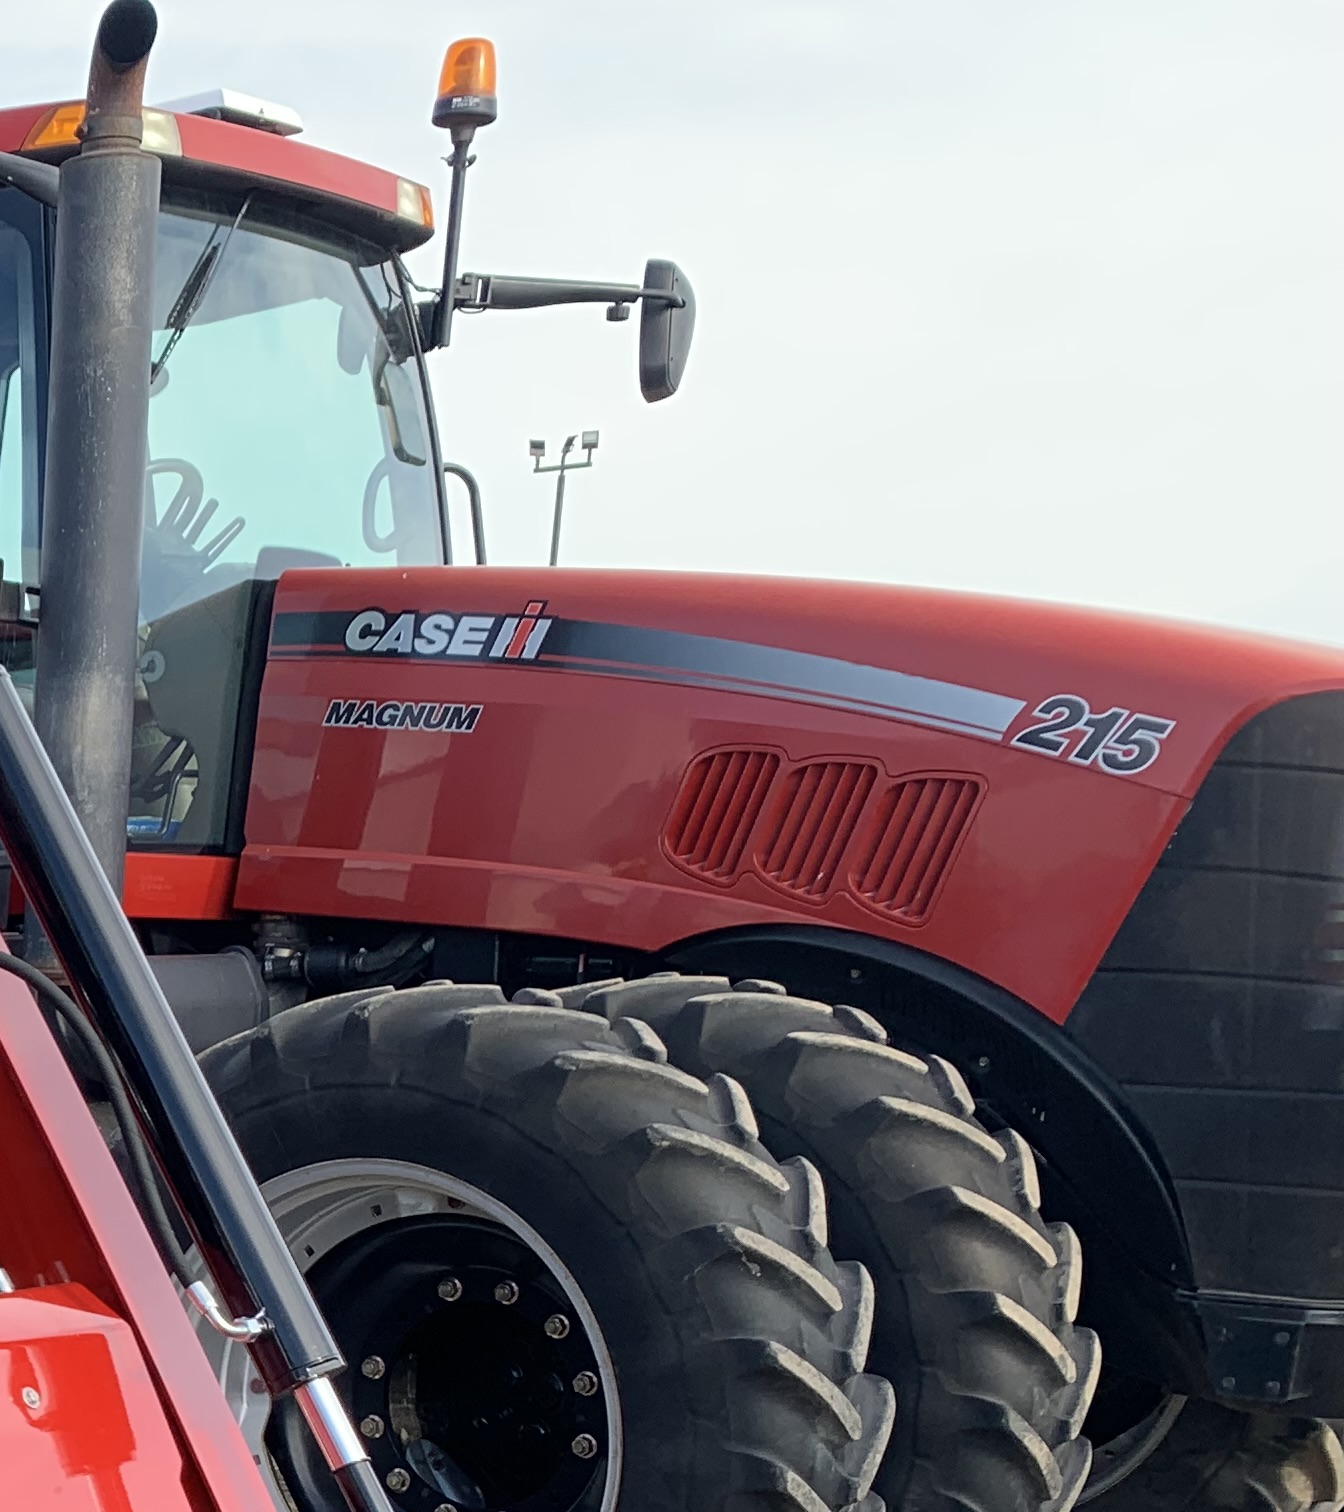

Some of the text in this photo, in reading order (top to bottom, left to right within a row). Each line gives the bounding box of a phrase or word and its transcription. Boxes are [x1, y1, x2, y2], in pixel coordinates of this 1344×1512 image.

[345, 610, 496, 657] CASE
[322, 699, 484, 733] MAGNUM
[1010, 693, 1177, 776] 215
